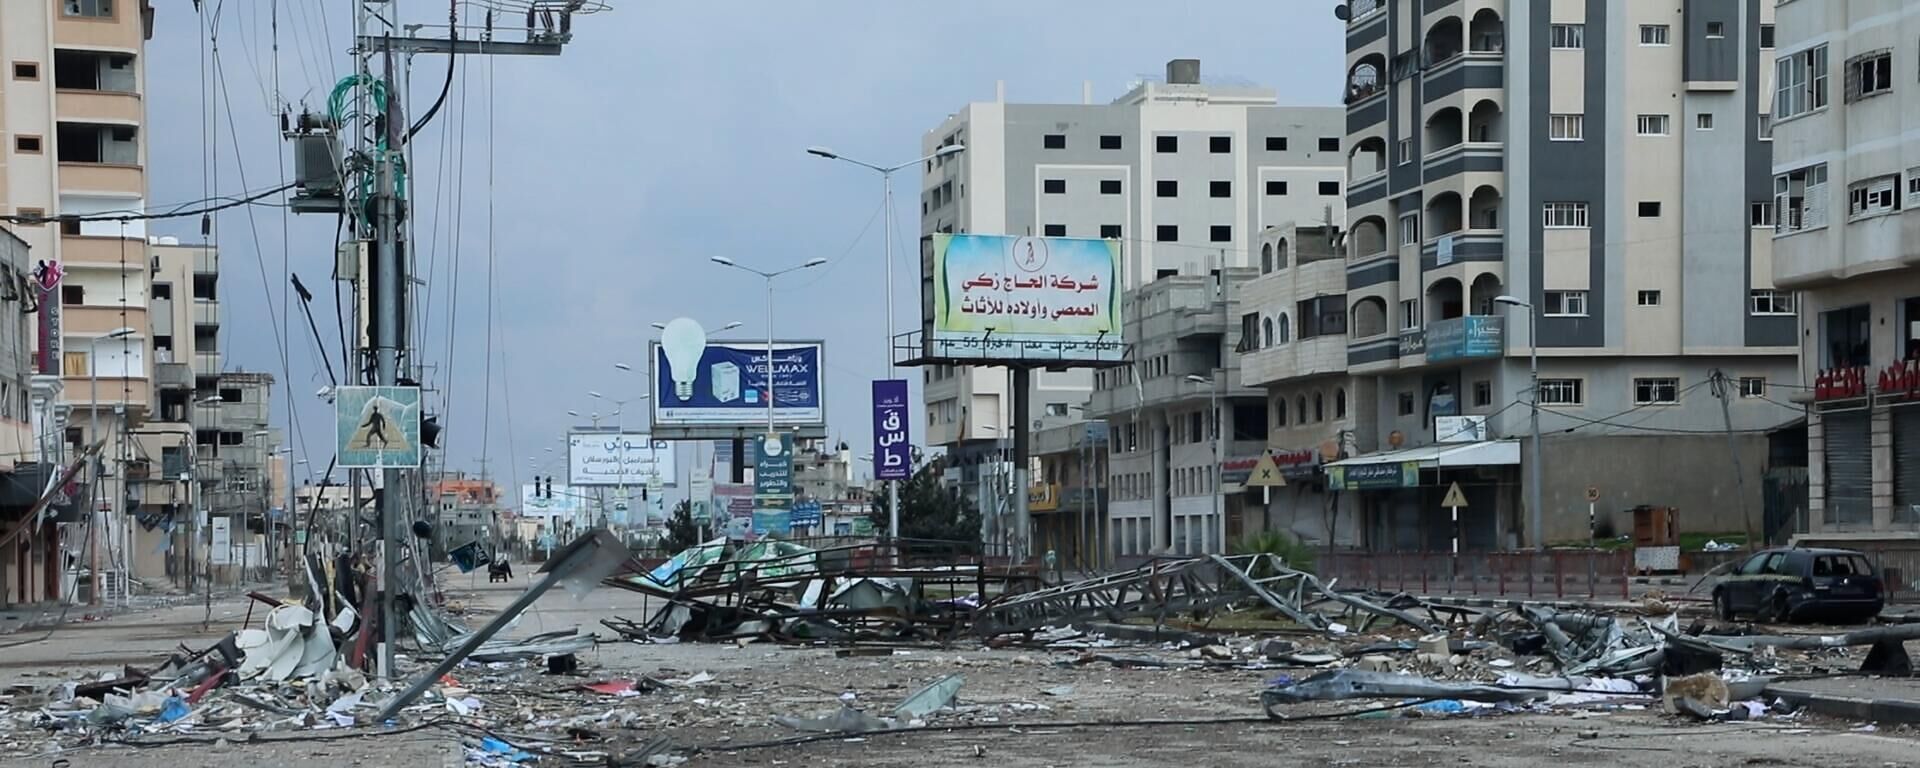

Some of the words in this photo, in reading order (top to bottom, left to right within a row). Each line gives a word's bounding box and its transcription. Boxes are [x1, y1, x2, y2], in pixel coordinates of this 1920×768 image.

[961, 272, 1000, 290] زكي
[1003, 275, 1047, 292] الحاج
[1051, 274, 1099, 293] شركة
[1051, 303, 1099, 320] العمصي
[745, 364, 809, 374] WELLMAX
